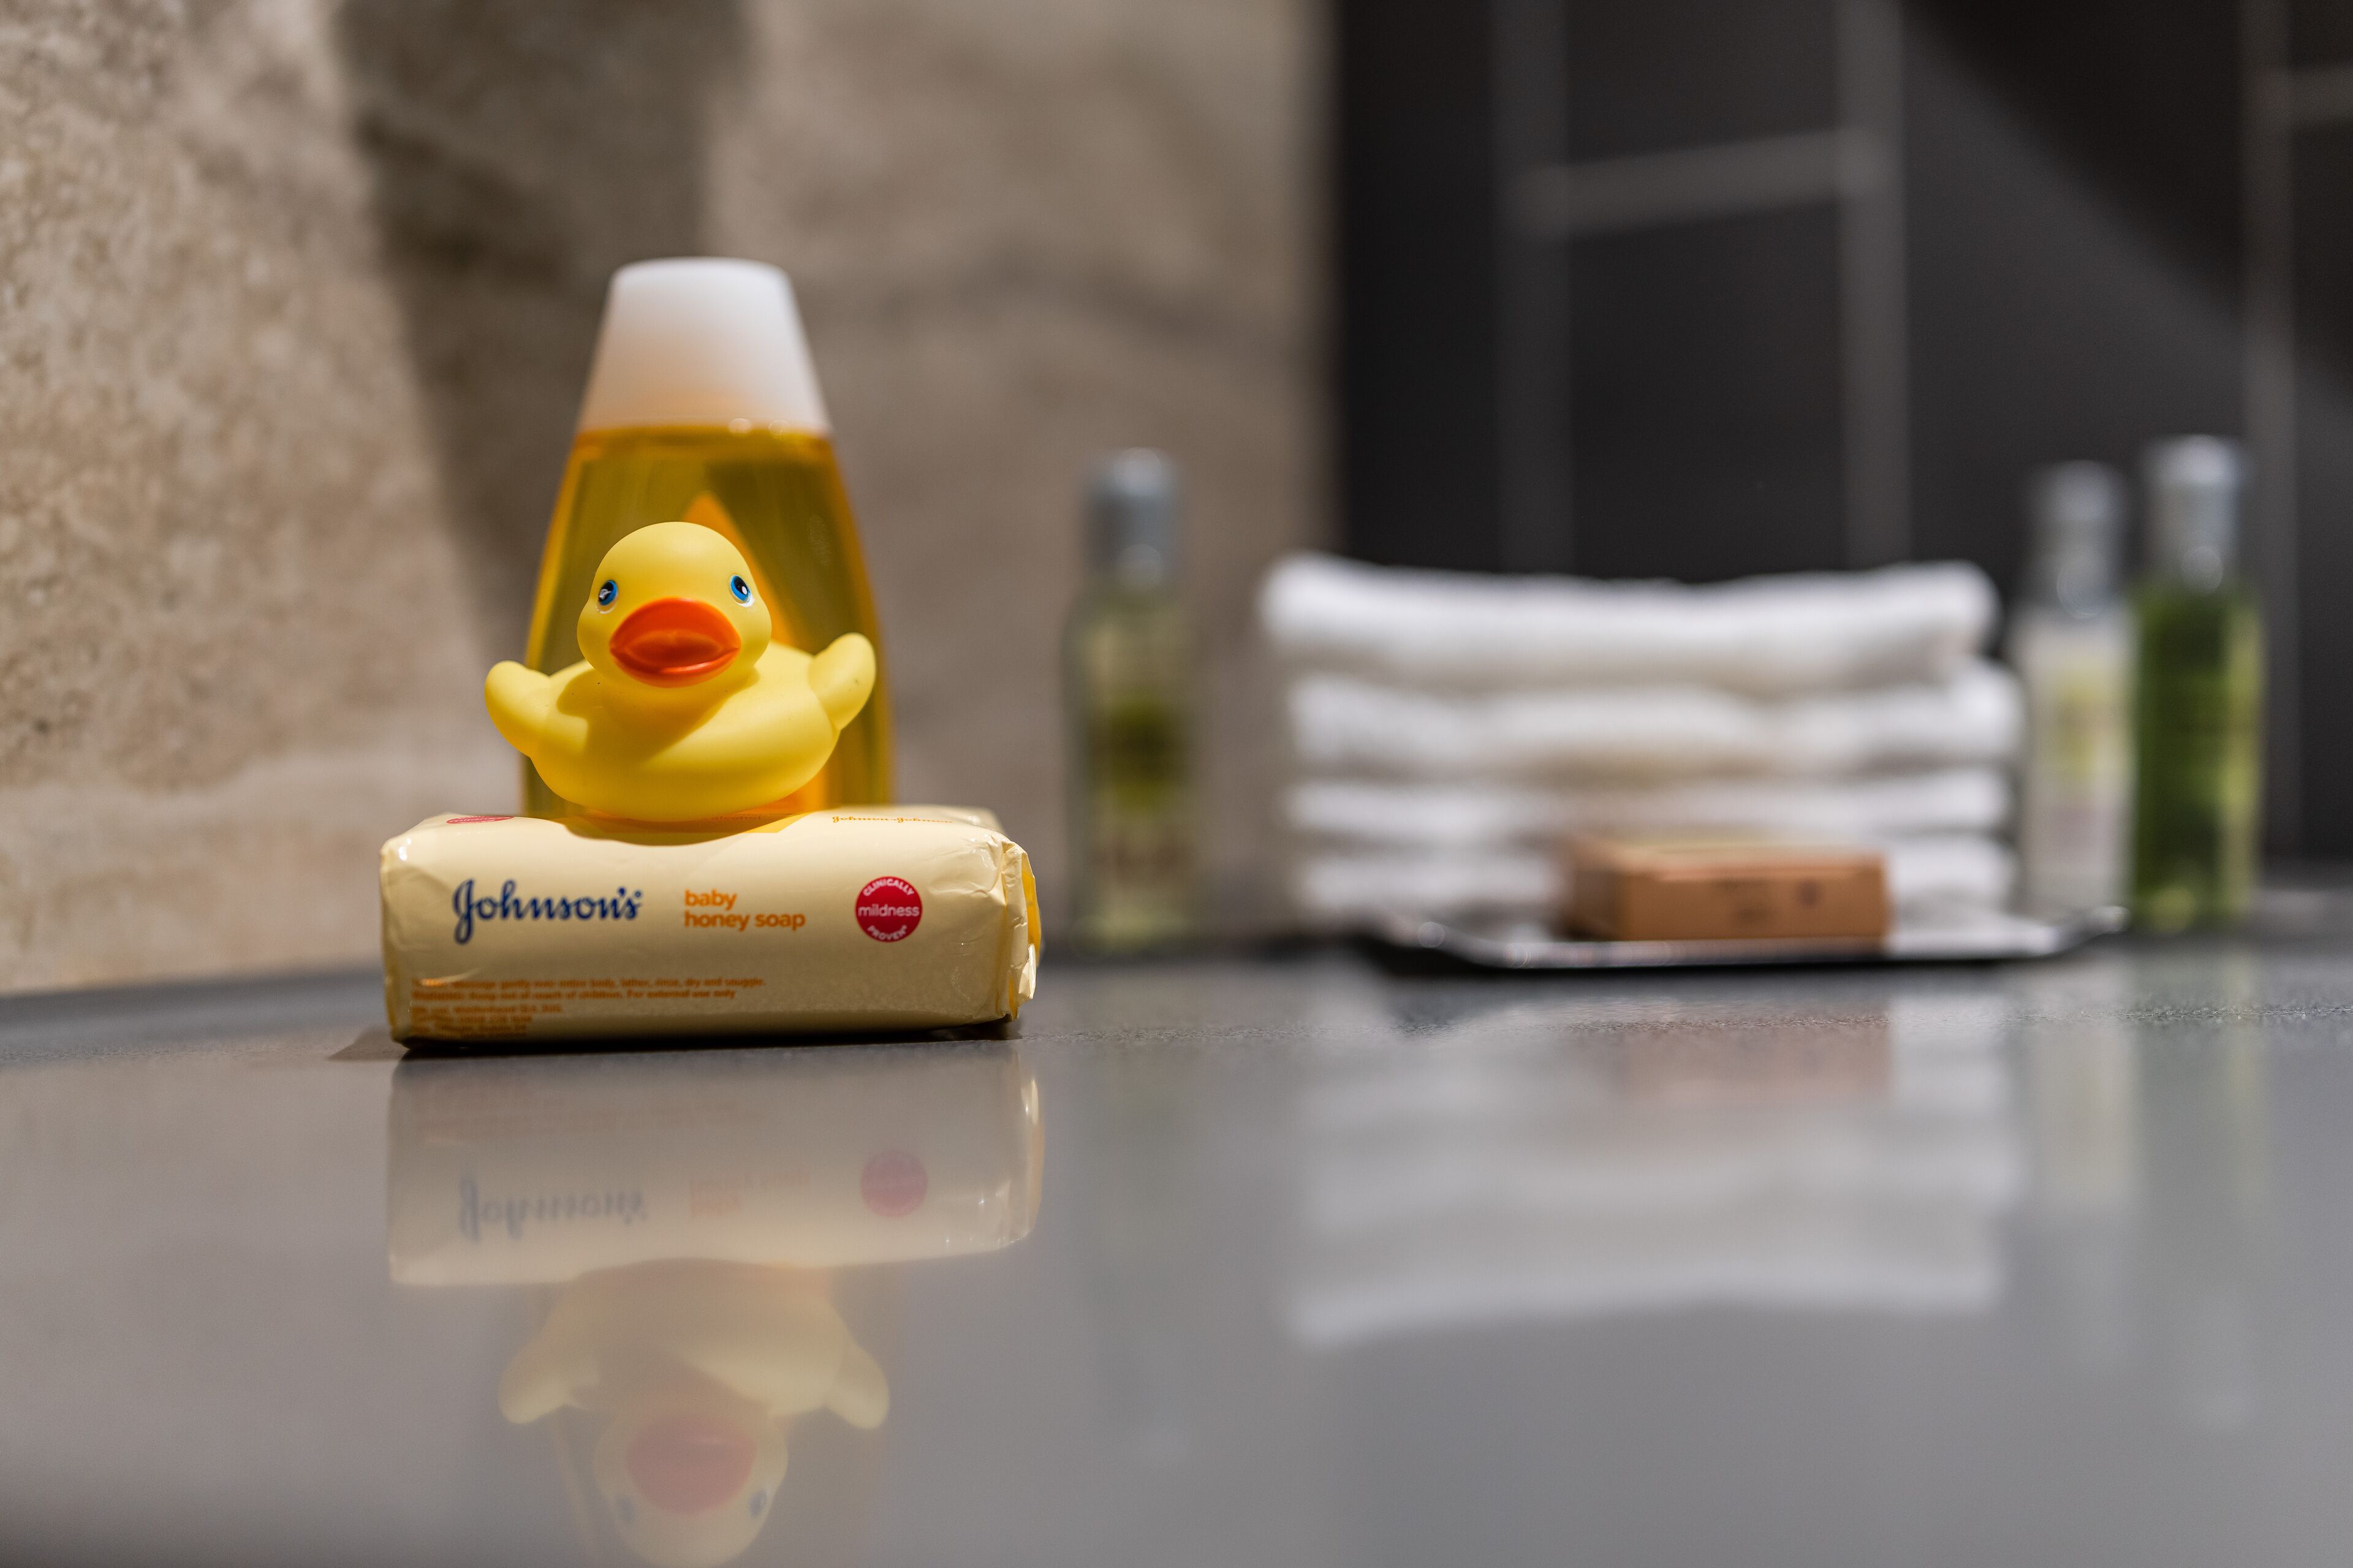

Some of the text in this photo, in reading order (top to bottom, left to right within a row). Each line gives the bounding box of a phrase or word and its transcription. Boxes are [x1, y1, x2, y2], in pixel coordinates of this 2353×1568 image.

[863, 878, 915, 896] CLINICALLY
[684, 888, 738, 911] baby
[858, 903, 920, 917] mildness
[452, 879, 642, 945] Johnson's
[684, 910, 806, 932] honey soap
